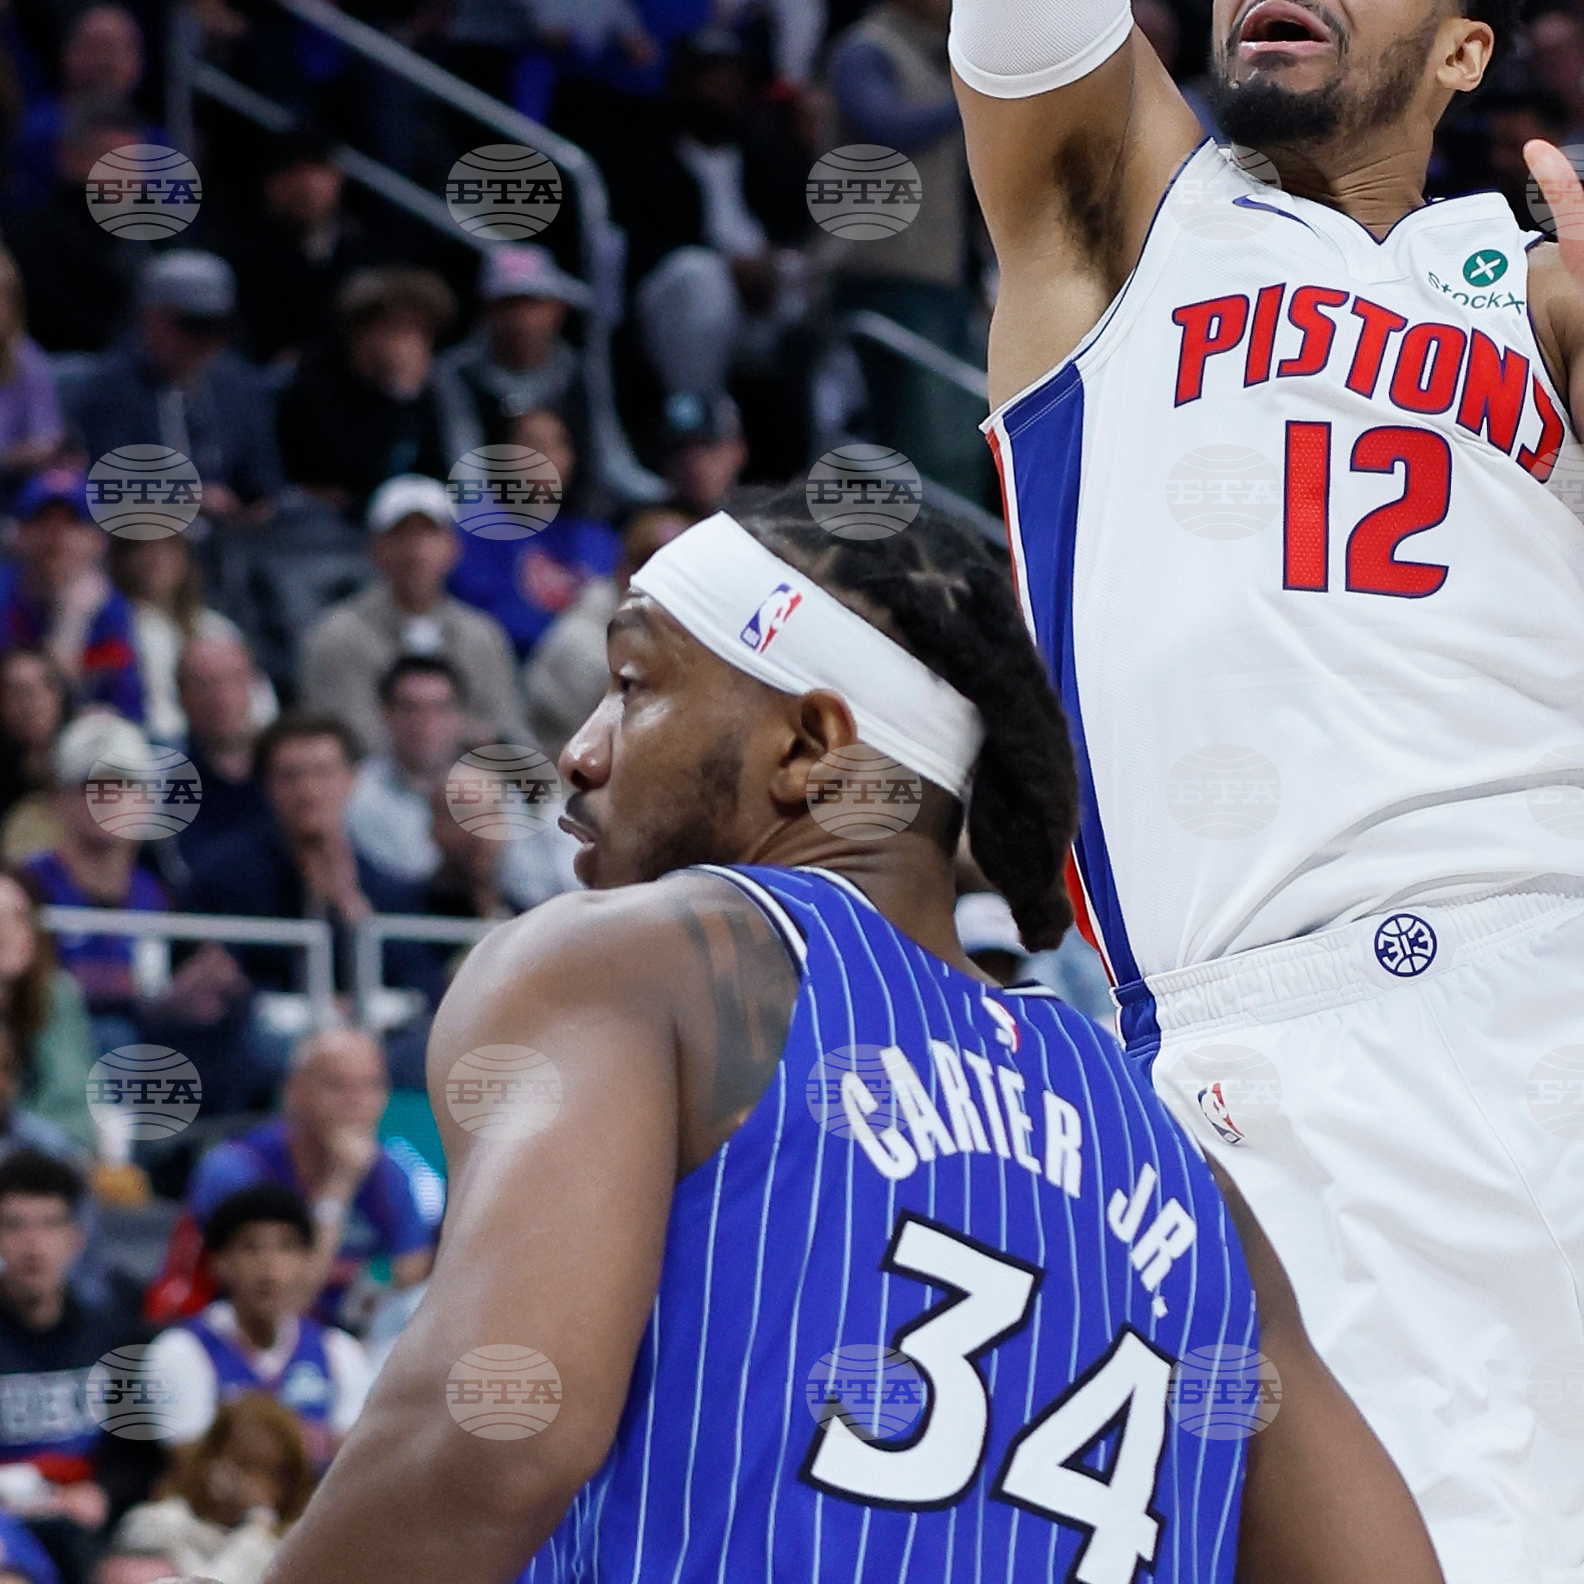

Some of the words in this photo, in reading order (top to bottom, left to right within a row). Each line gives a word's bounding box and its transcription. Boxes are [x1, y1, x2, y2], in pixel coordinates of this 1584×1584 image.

[1282, 419, 1452, 599] 12
[840, 1045, 1082, 1199] CARTER
[1106, 1163, 1198, 1318] JR.
